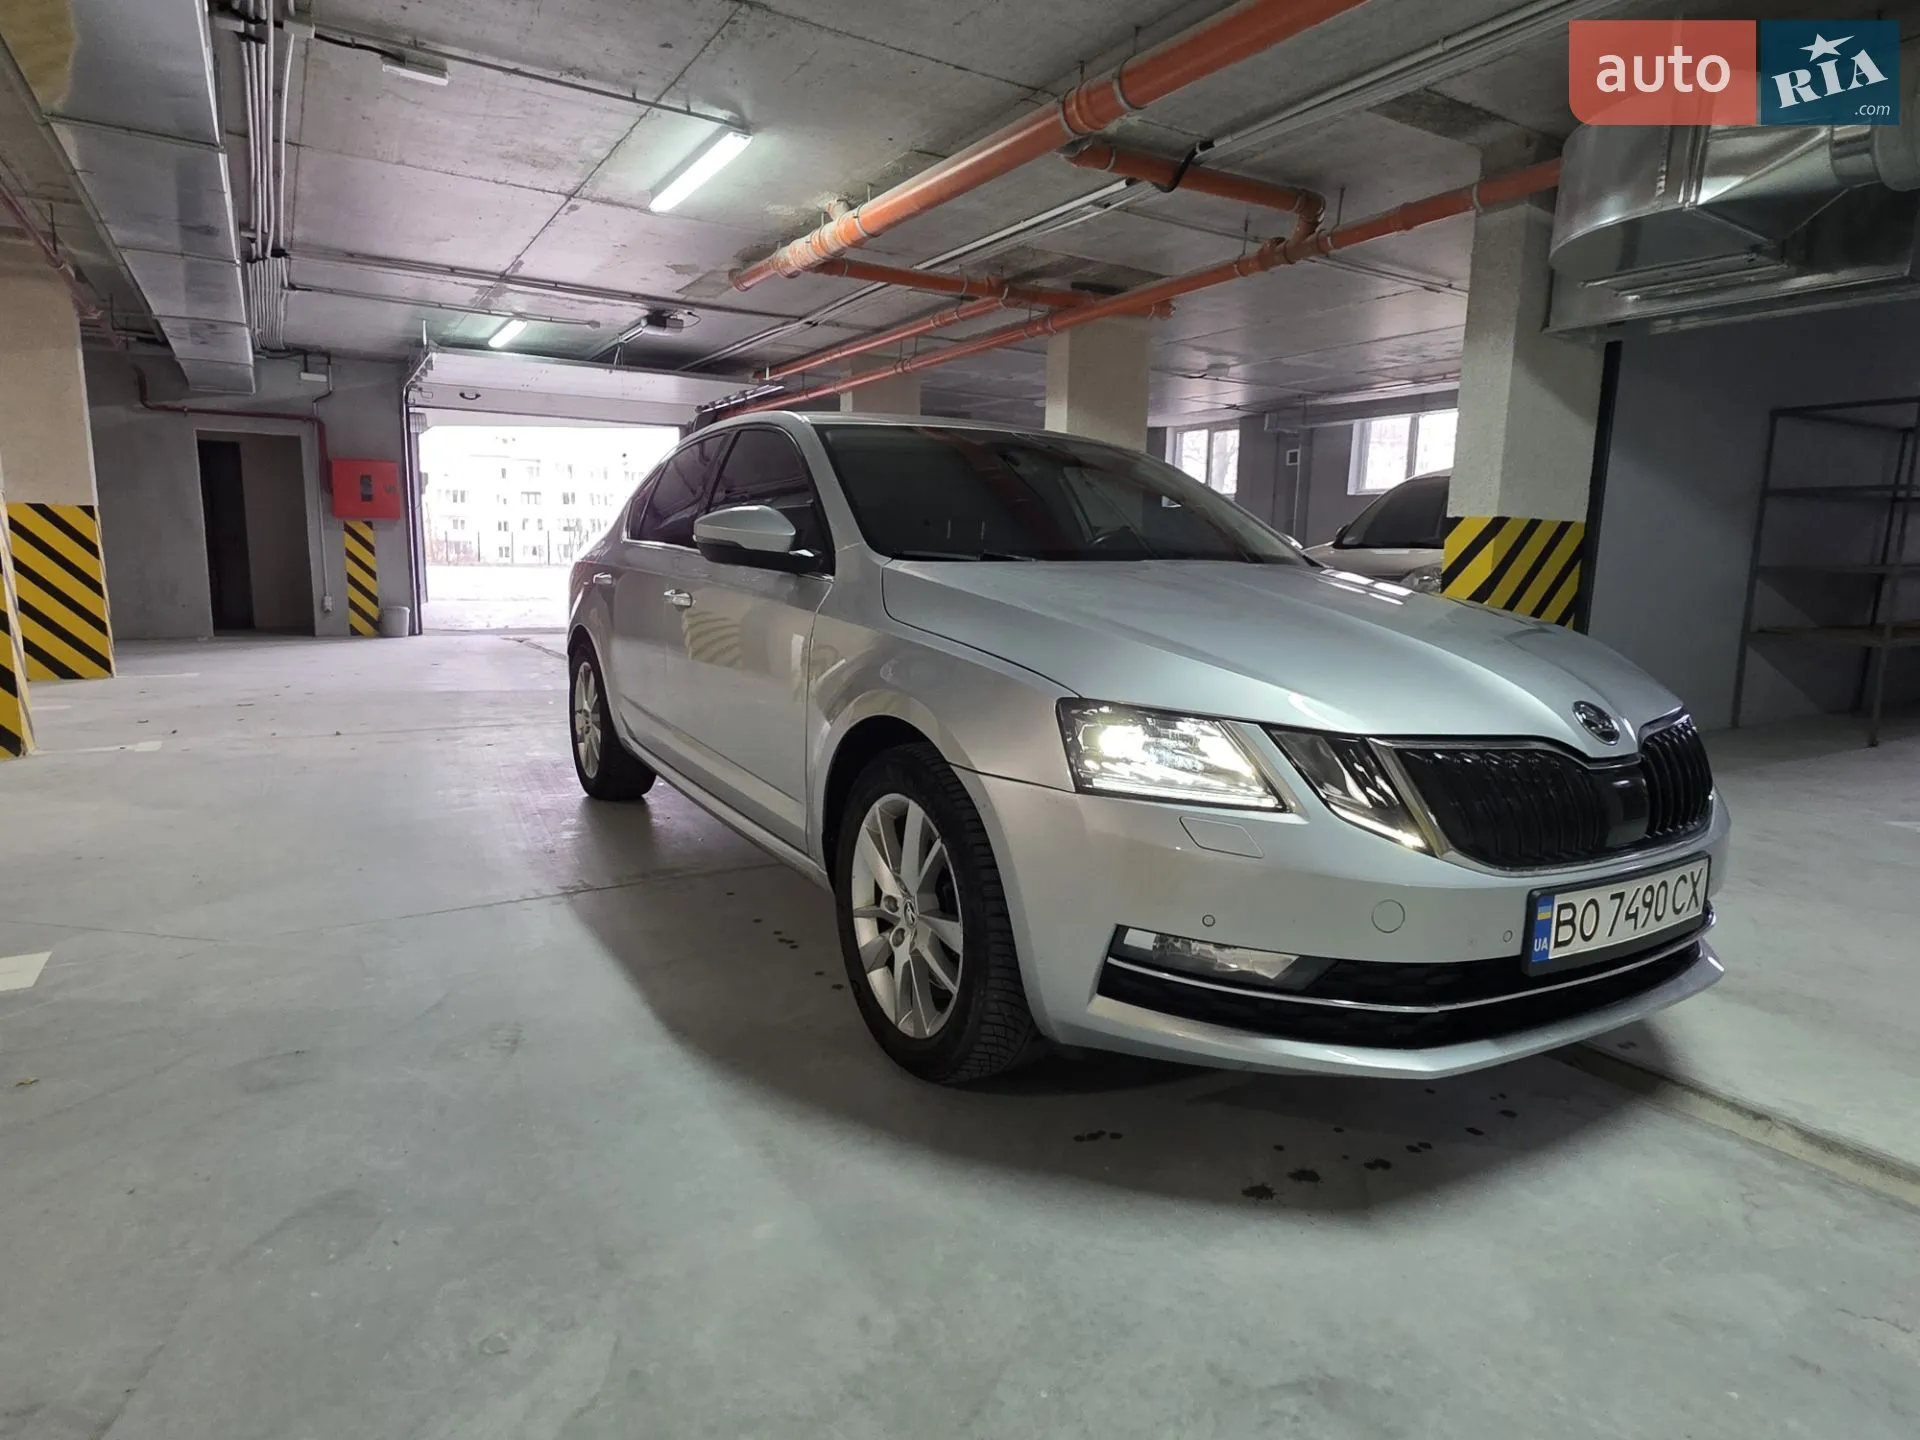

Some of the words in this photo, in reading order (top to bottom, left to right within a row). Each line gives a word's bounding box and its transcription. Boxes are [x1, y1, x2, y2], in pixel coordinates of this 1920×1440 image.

[1553, 898, 1600, 949] BO
[1607, 880, 1668, 937] 7490
[1672, 868, 1704, 915] CX
[1534, 938, 1549, 952] UA
